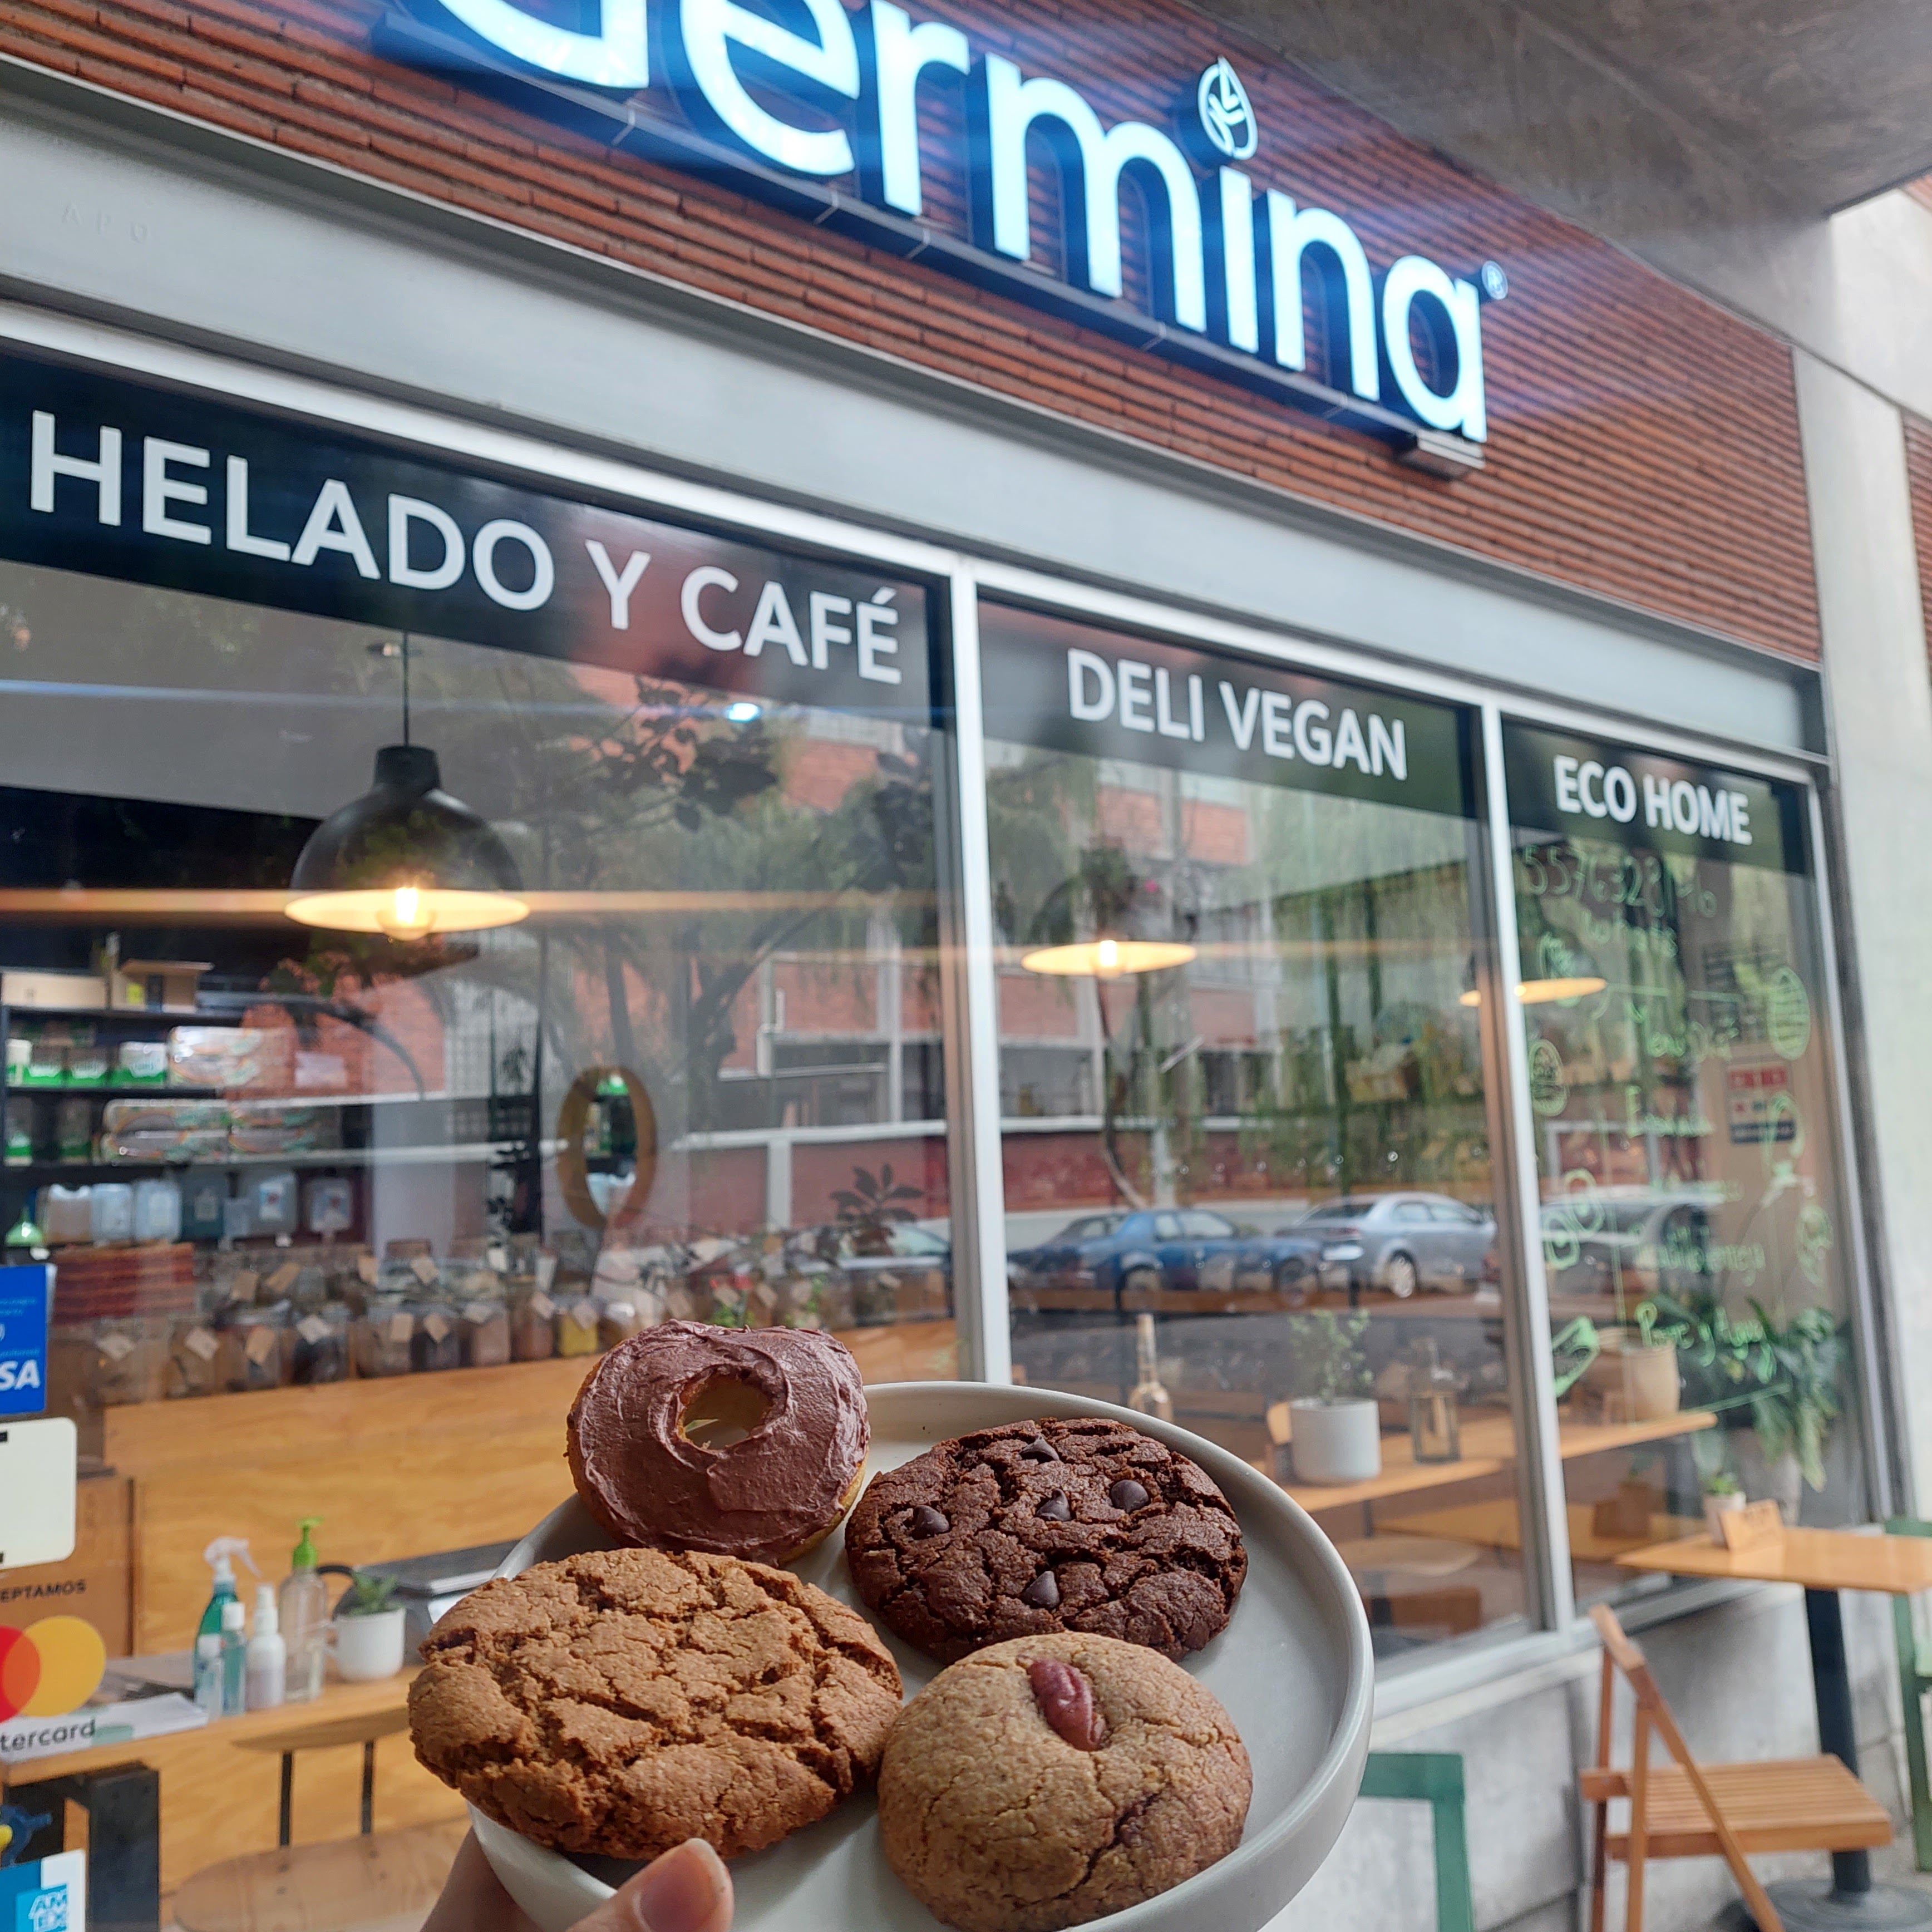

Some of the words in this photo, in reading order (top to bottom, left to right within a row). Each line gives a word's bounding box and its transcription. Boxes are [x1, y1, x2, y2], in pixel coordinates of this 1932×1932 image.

[30, 409, 555, 611] HELADO
[585, 539, 652, 630] Y
[680, 565, 903, 685] CAFÉ
[1067, 647, 1206, 743] DELI
[1219, 681, 1408, 781] VEGAN
[1552, 755, 1638, 823] ECO
[1642, 773, 1753, 846] HOME
